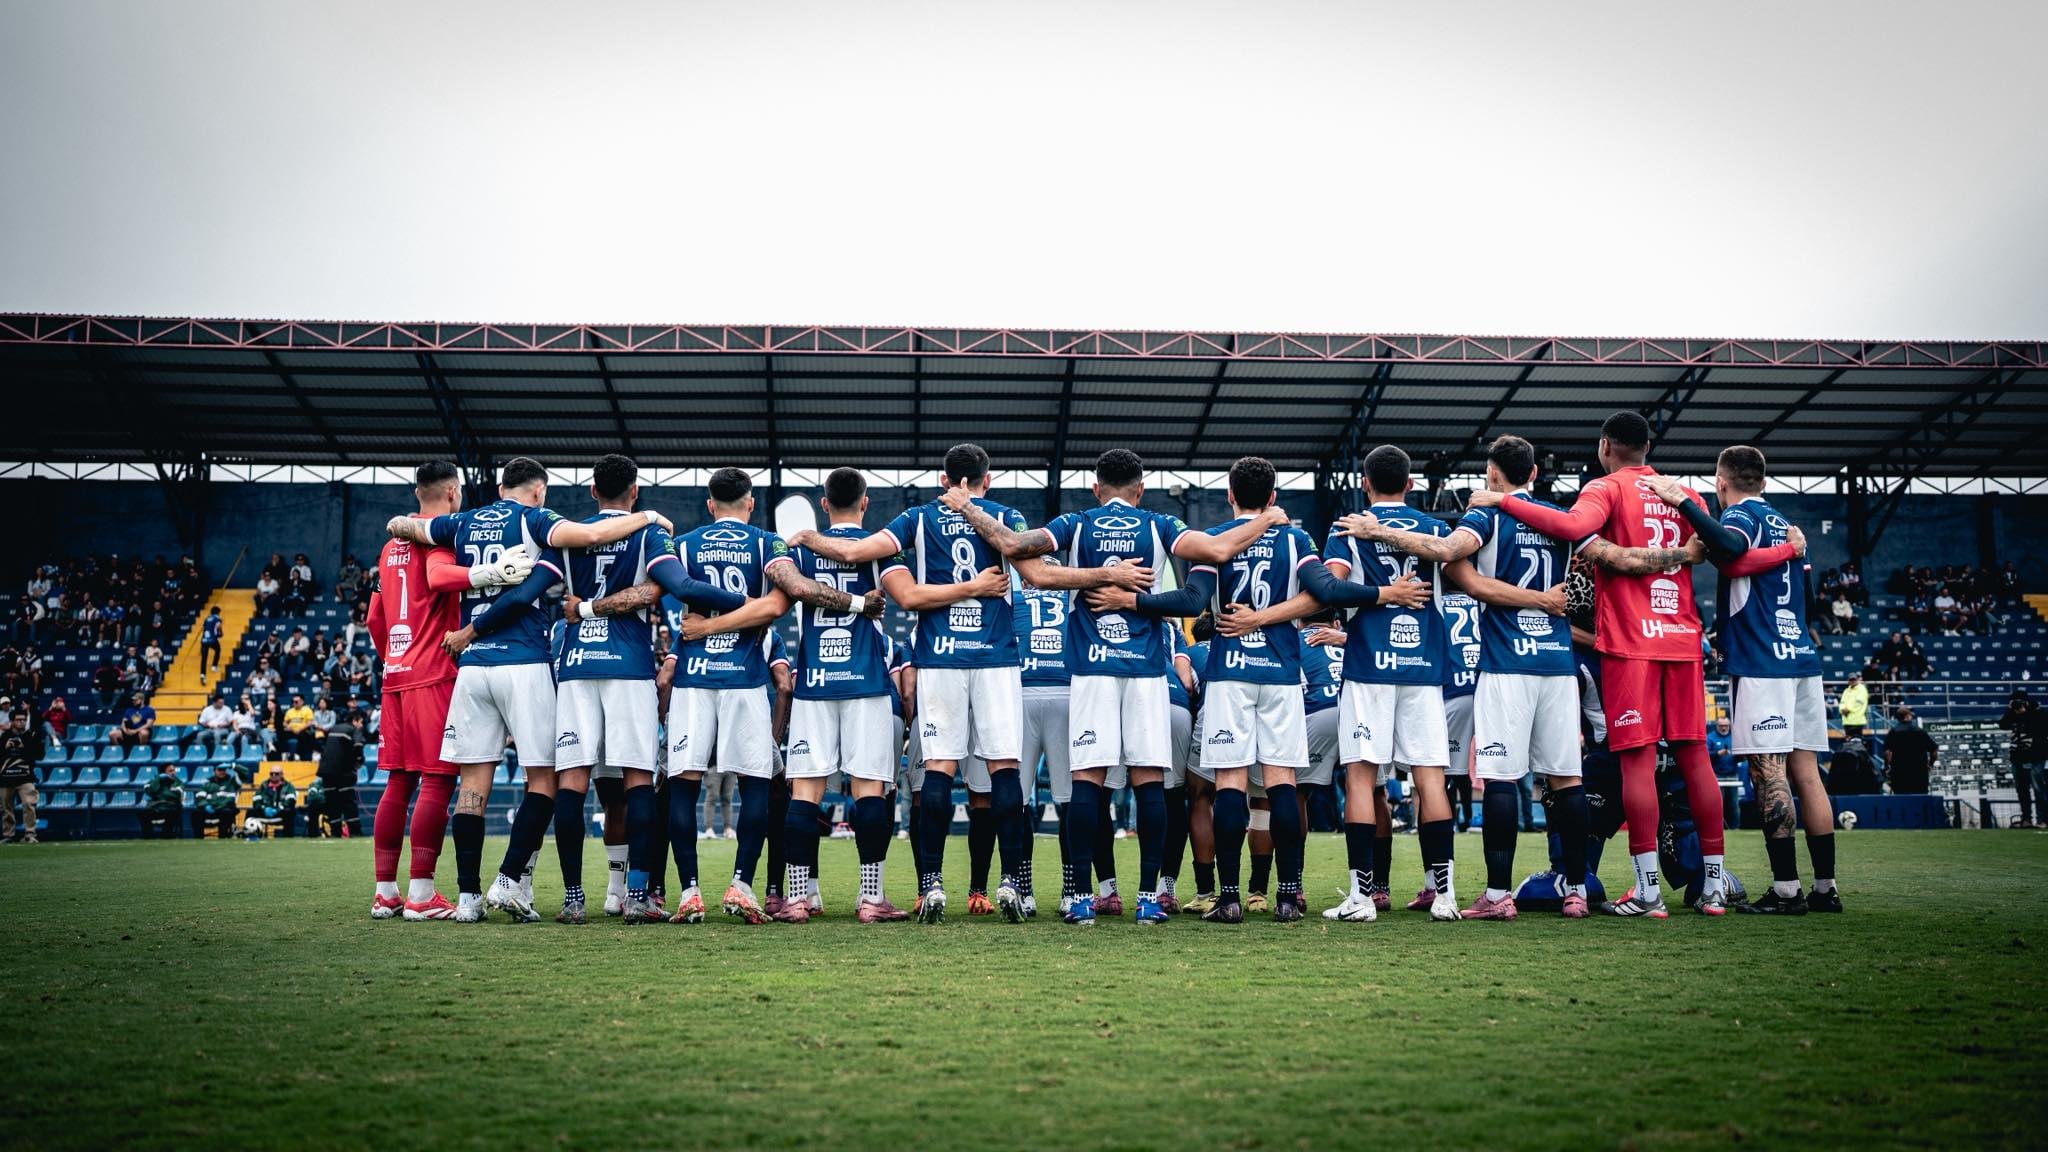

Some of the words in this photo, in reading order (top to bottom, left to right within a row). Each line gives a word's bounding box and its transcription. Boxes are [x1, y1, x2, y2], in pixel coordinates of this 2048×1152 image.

[1821, 520, 1833, 534] F
[701, 541, 748, 550] CHERY
[1096, 540, 1135, 552] JOHAN
[697, 550, 752, 564] BARAHONA
[951, 538, 979, 583] 8
[1517, 548, 1553, 593] 21
[595, 555, 616, 600] 5
[1232, 560, 1271, 613] 76
[397, 568, 409, 620] 1
[1650, 588, 1679, 599] BURGER
[1650, 597, 1679, 610] KING
[949, 608, 982, 616] BURGER
[1025, 597, 1065, 627] 13
[949, 615, 982, 627] KING
[1517, 616, 1549, 625] BURGER
[578, 626, 609, 637] KING
[1390, 624, 1420, 632] BURGER
[819, 638, 852, 647] BURGER
[1030, 634, 1062, 642] BURGER
[1389, 631, 1421, 642] KING
[819, 646, 852, 657] KING
[1030, 641, 1063, 650] KING
[1513, 636, 1538, 656] UH
[1614, 716, 1643, 728] Electrolit
[1751, 722, 1789, 732] Electrolit
[1706, 864, 1719, 879] FS
